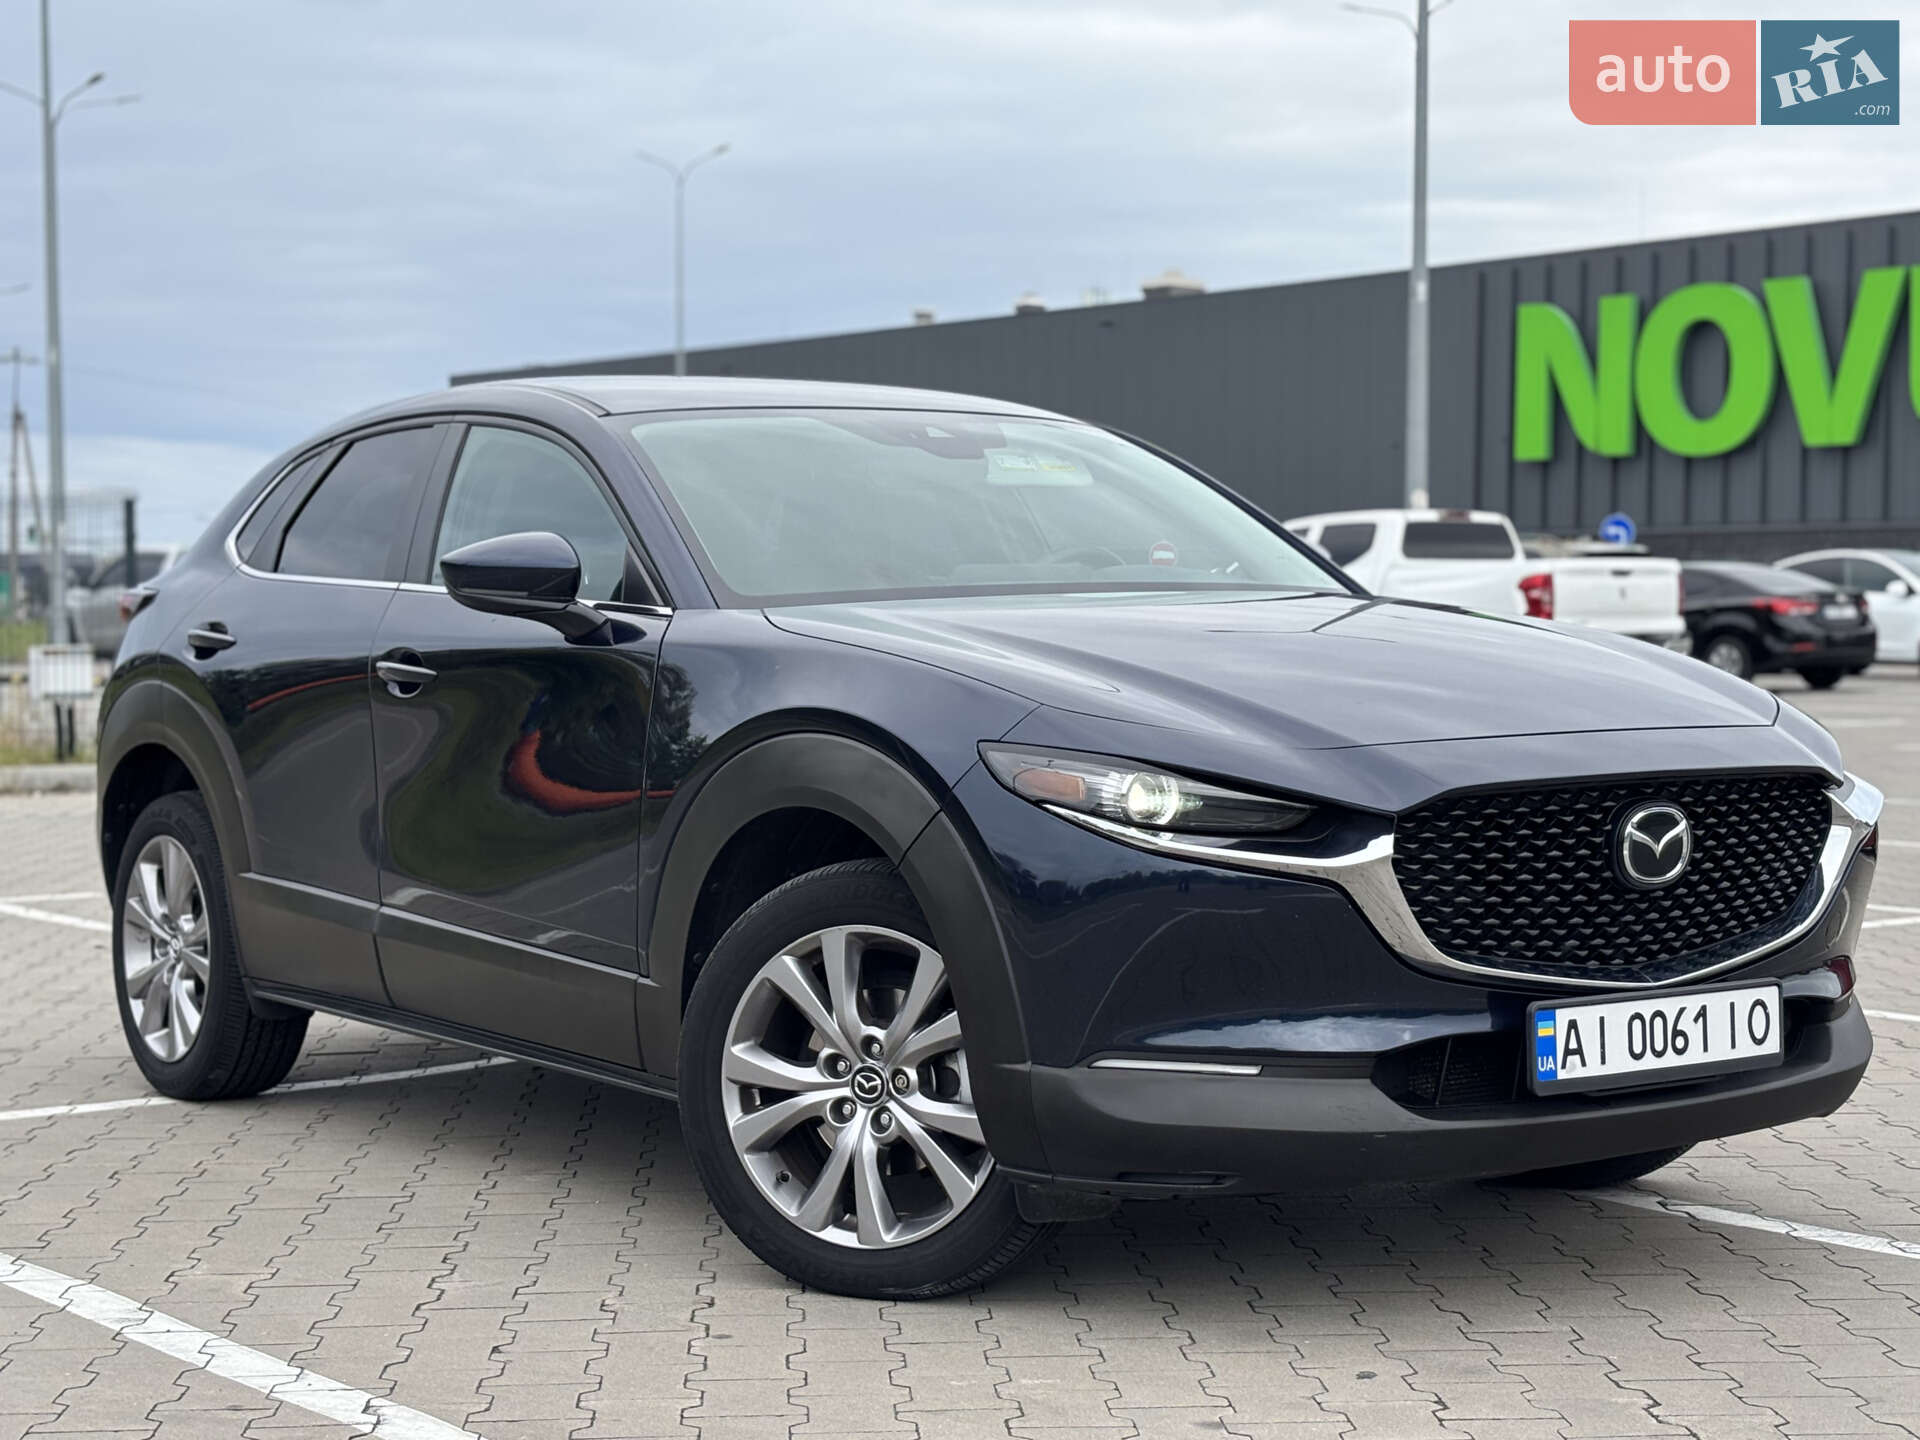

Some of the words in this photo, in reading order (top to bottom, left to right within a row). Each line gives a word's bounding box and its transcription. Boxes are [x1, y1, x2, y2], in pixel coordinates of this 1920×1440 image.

[1513, 265, 1920, 463] NOV
[1537, 1055, 1556, 1072] UA
[1560, 1014, 1607, 1070] AI
[1627, 1004, 1709, 1061] 0061
[1729, 998, 1771, 1049] IO
